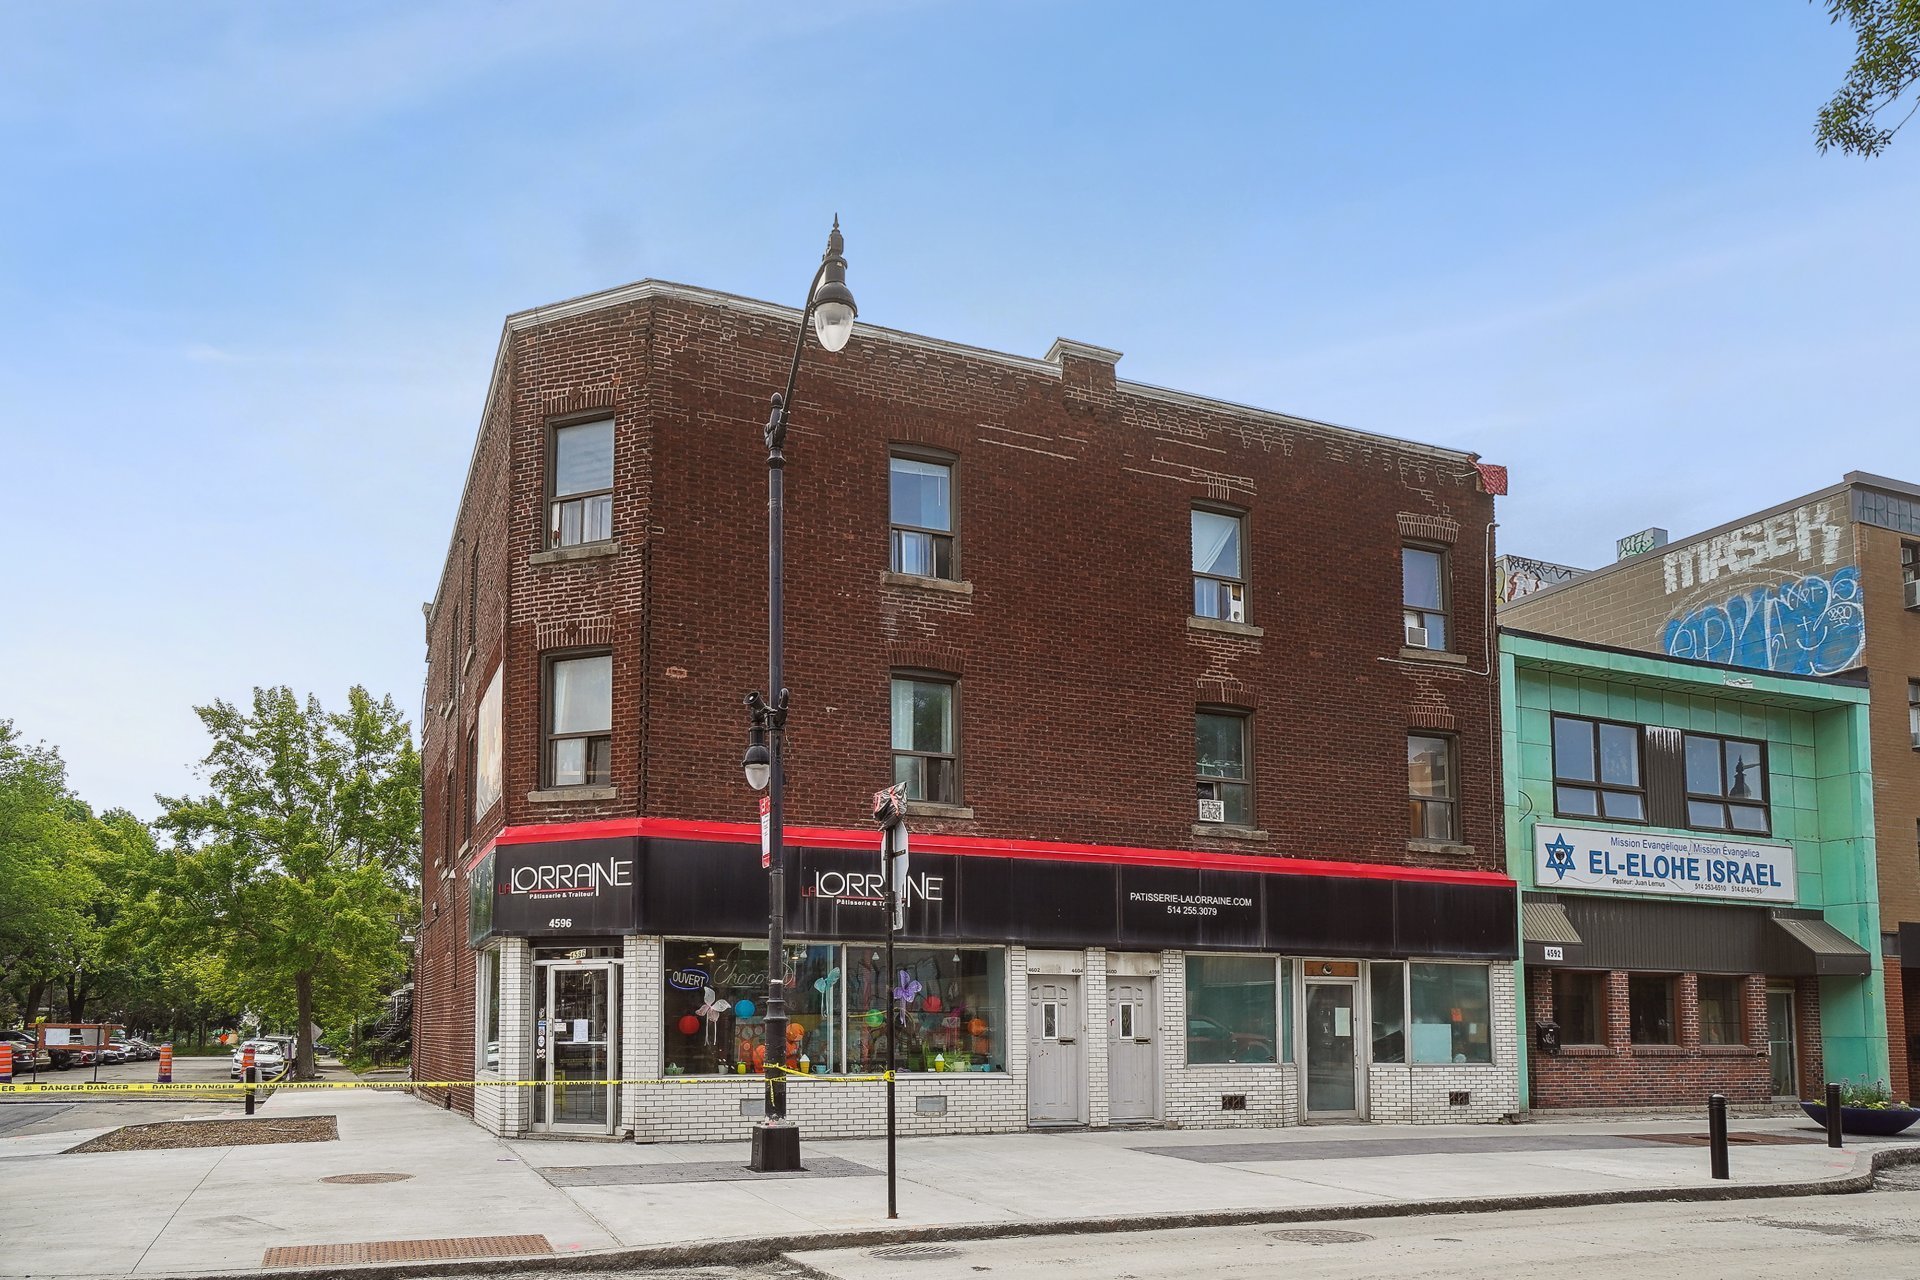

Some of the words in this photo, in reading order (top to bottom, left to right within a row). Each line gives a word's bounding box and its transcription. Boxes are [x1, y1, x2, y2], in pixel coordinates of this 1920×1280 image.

[1611, 837, 1640, 848] Mission
[1642, 839, 1688, 853] Evangélique
[1694, 843, 1721, 855] Mission
[1589, 849, 1700, 881] EL-ELOHE
[1706, 859, 1782, 887] ISRAEL
[498, 882, 511, 895] LA
[511, 856, 633, 897] LORRAINE
[1635, 879, 1648, 887] Juan
[1648, 880, 1666, 888] Lemus
[1694, 883, 1704, 891] 514
[816, 871, 944, 908] LORRINE
[529, 892, 561, 900] Pâtisserie
[1130, 892, 1252, 907] PATISSERIE-LALORRAINE.COM
[836, 899, 871, 907] Pâtisserie
[1167, 905, 1181, 915] 514
[1183, 906, 1218, 916] 255.3079
[549, 918, 572, 928] 4596
[1547, 949, 1561, 958] 4592
[672, 970, 705, 987] OUVERT
